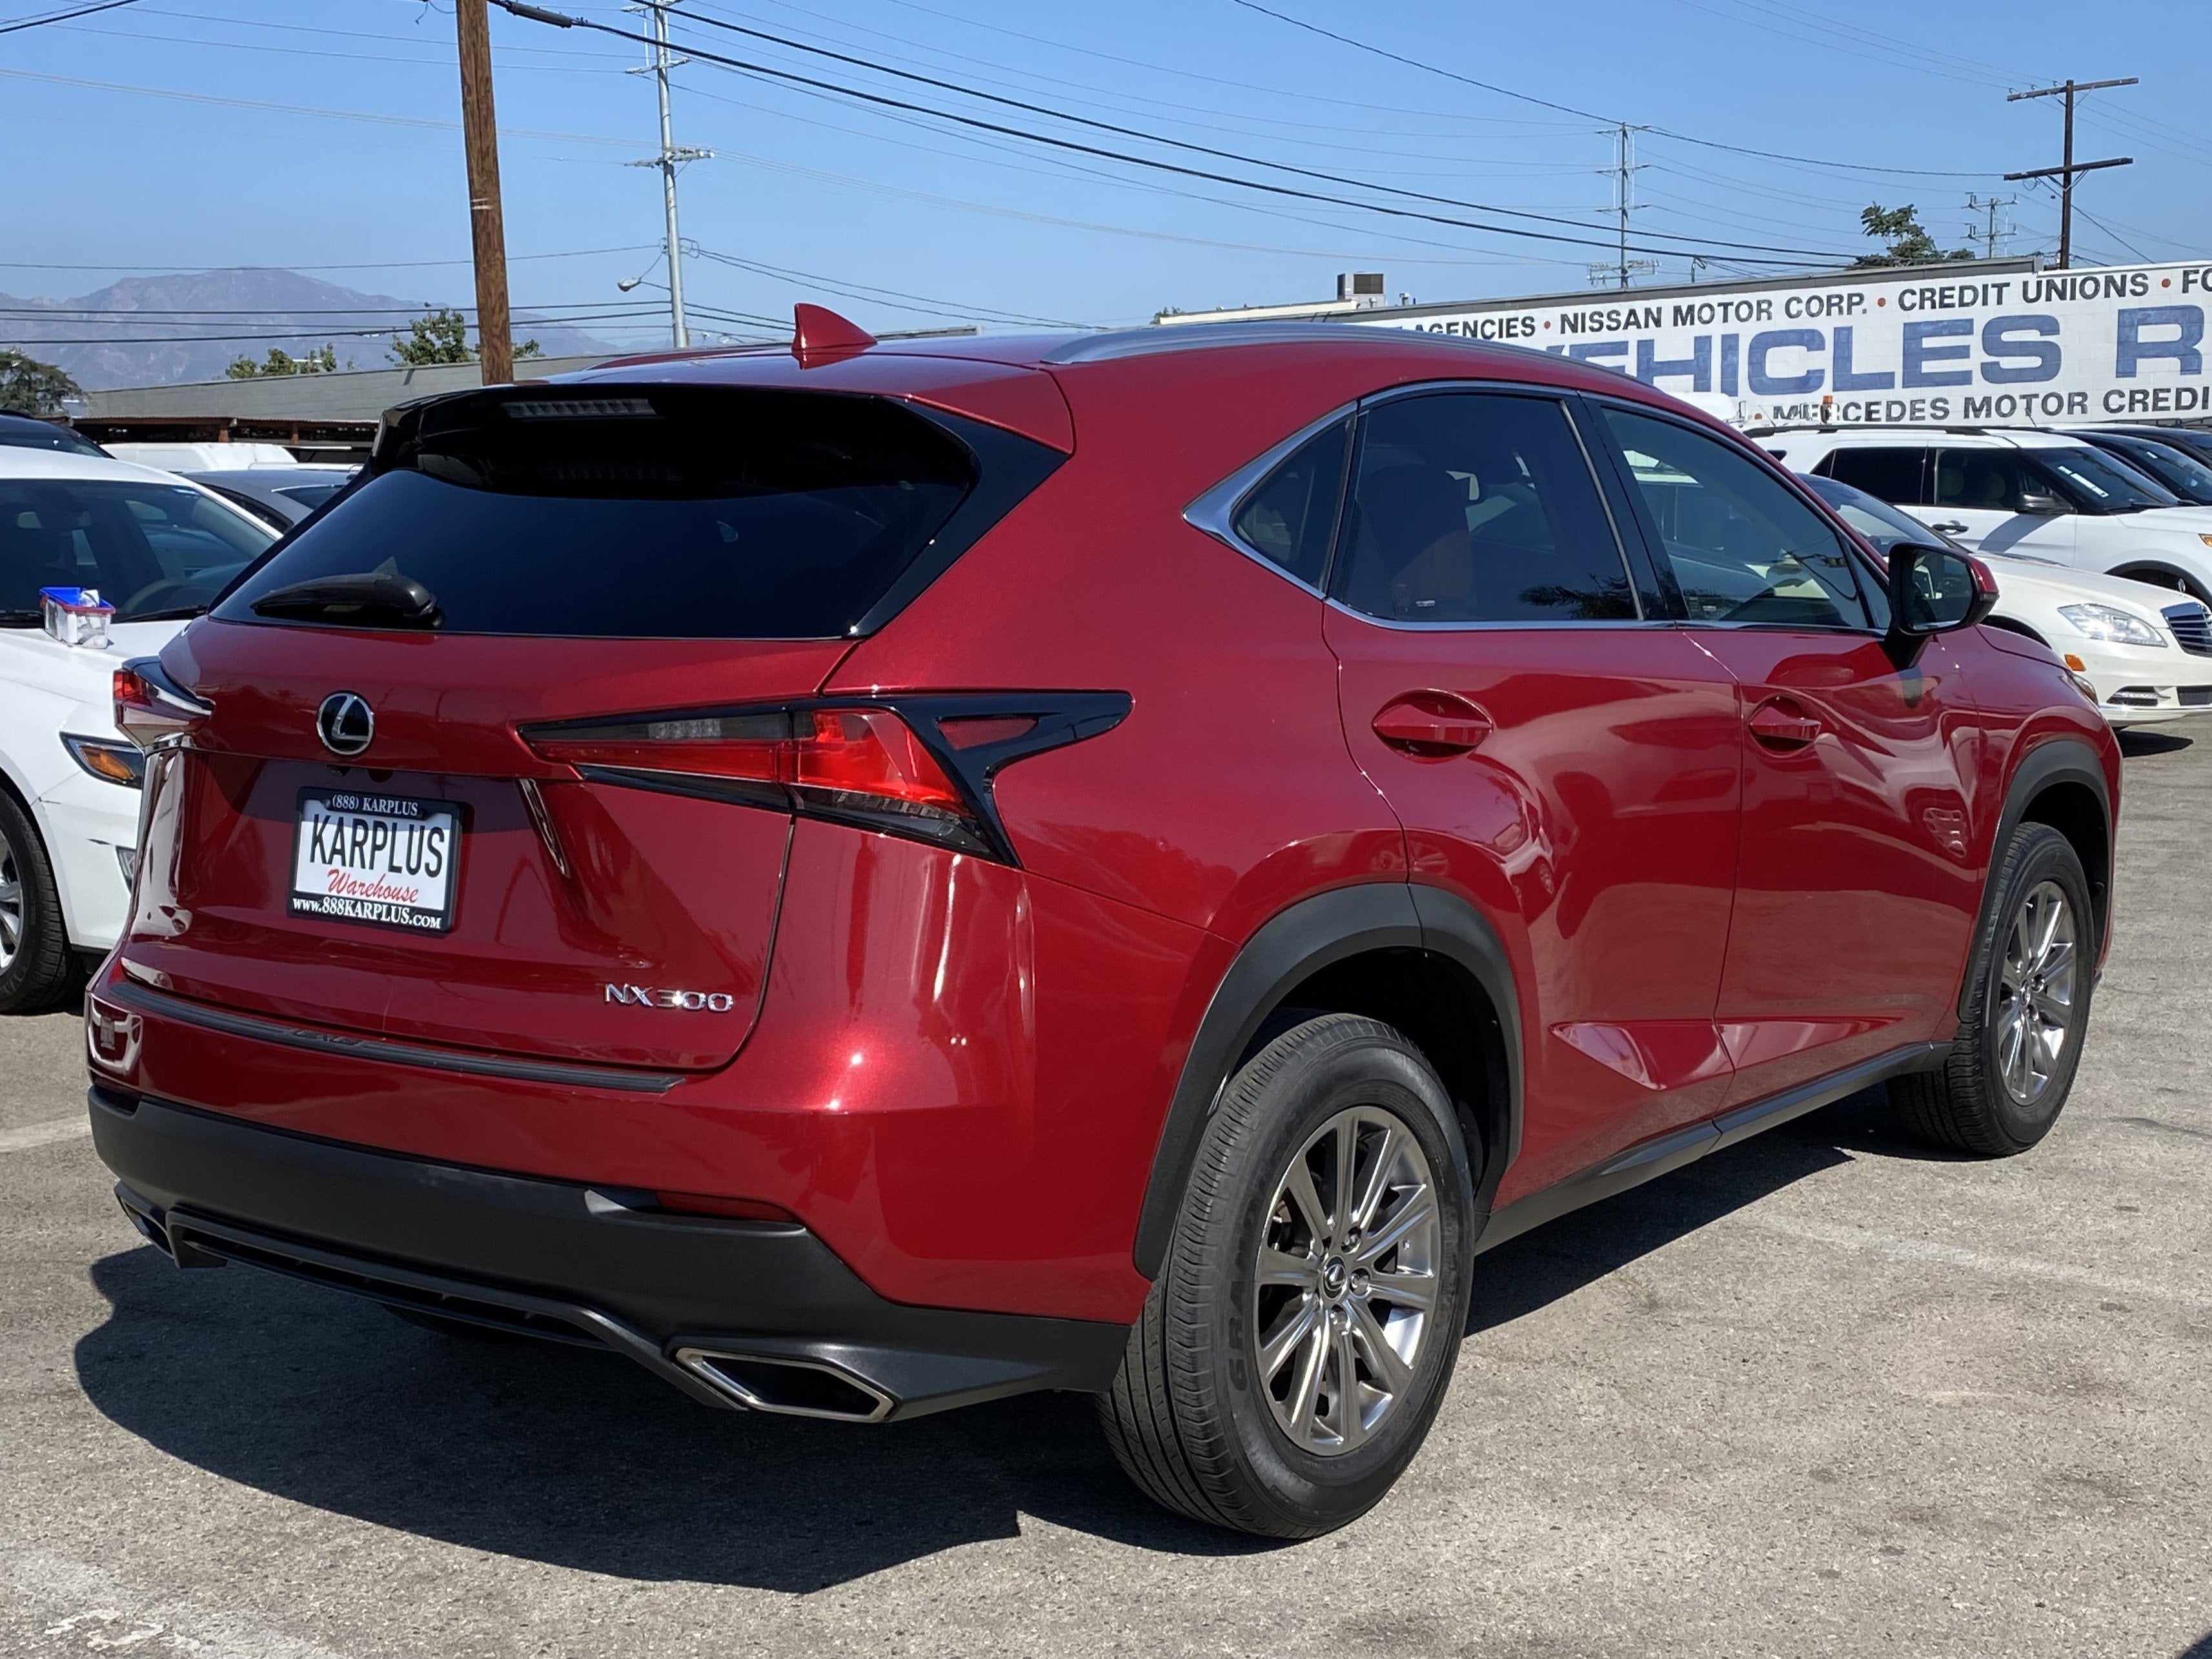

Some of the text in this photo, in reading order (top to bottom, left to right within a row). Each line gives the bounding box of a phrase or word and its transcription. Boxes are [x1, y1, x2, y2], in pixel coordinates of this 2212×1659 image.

[1559, 305, 1662, 335] NISSAN
[1672, 298, 1772, 327] MOTOR
[1785, 292, 1868, 320] CORP.
[1898, 281, 2011, 312] CREDIT
[2022, 272, 2149, 305] UNIONS
[1546, 314, 2062, 397] HICLES
[1773, 386, 2210, 422] MECEDES MOTOR CREDI
[332, 794, 419, 817] (888) KARPLUS
[309, 813, 445, 879] KARPLUS
[327, 868, 420, 904] Warehouse
